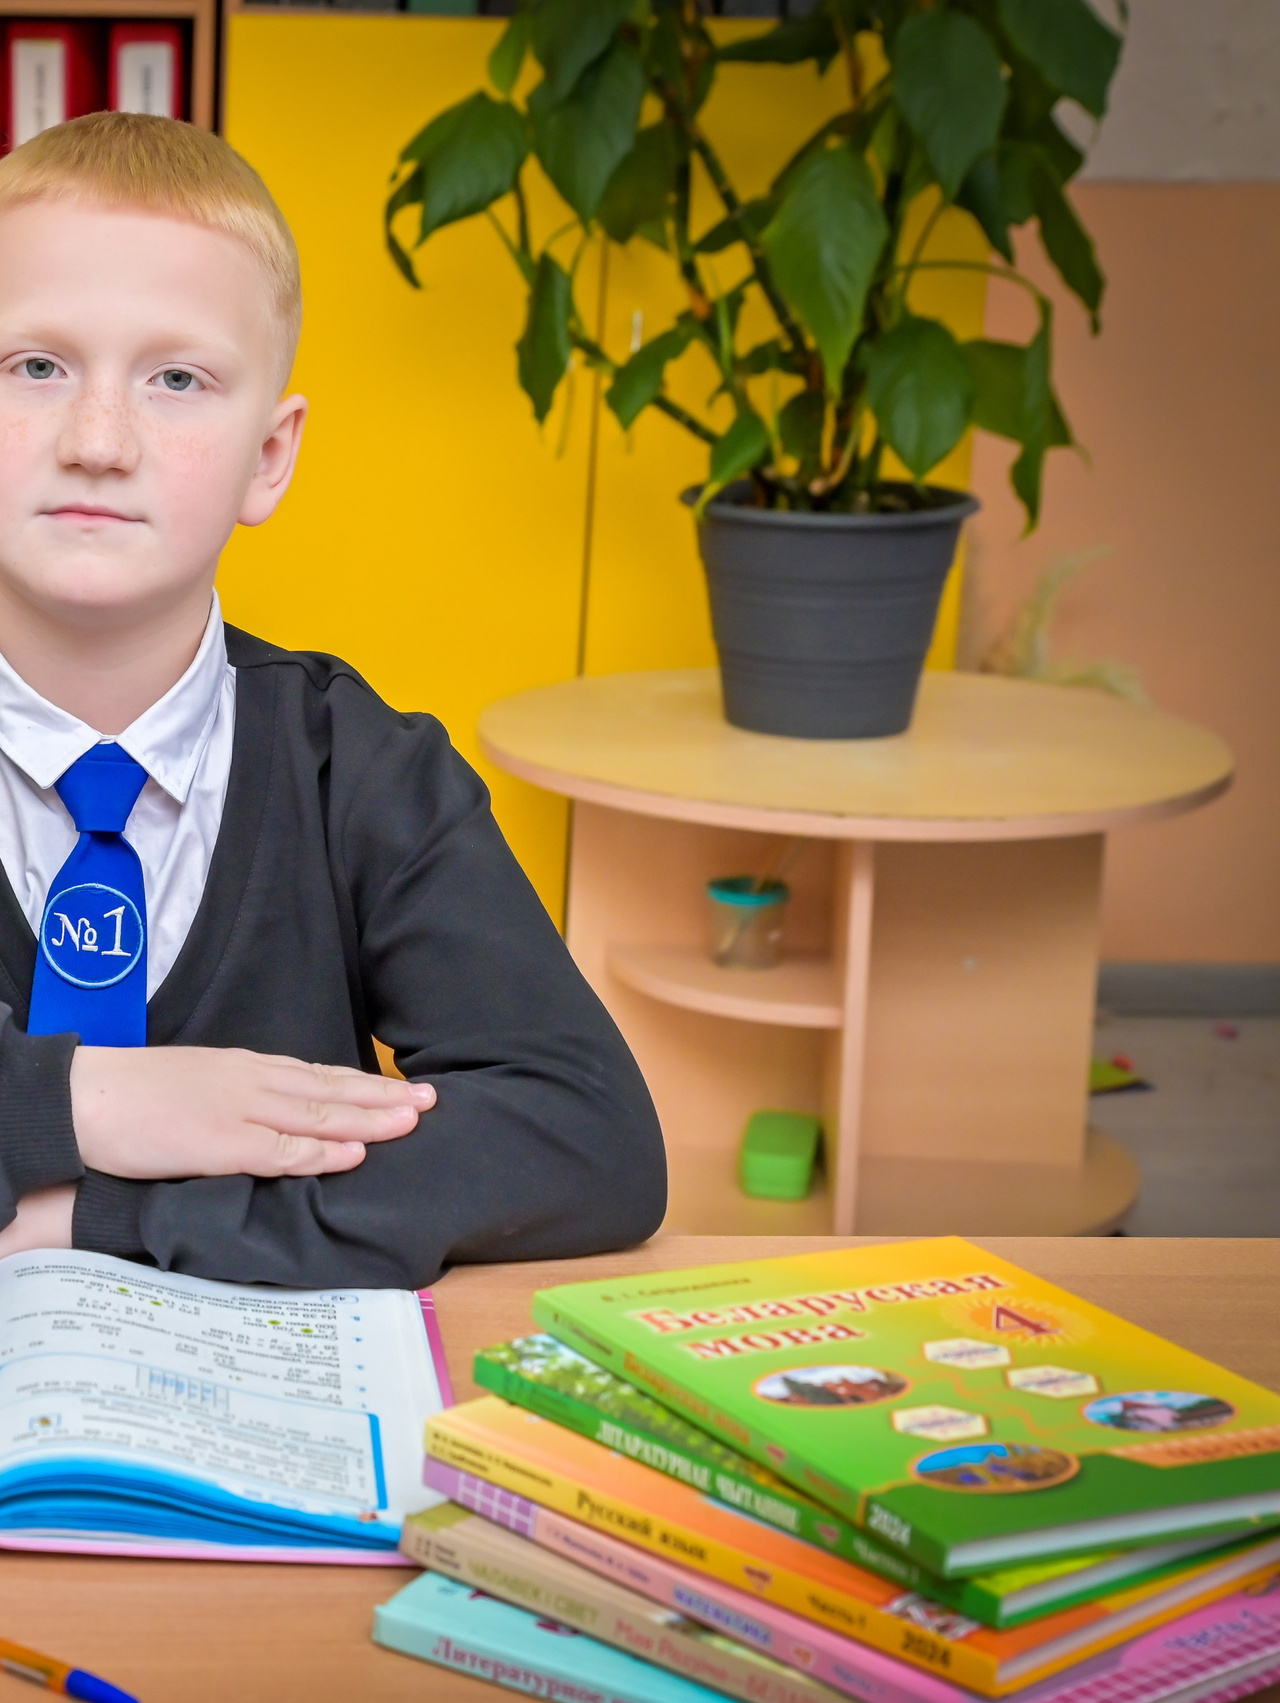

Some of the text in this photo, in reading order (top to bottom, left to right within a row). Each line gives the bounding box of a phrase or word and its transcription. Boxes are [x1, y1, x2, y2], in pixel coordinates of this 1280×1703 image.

[51, 905, 132, 957] №1
[637, 1273, 1006, 1334] Беларуская
[995, 1305, 1058, 1336] 4
[576, 1489, 652, 1539] Русский
[660, 1531, 706, 1560] язык
[868, 1503, 912, 1548] 2024
[673, 1586, 772, 1646] МАТЕМАТИКА
[901, 1630, 952, 1670] 2024
